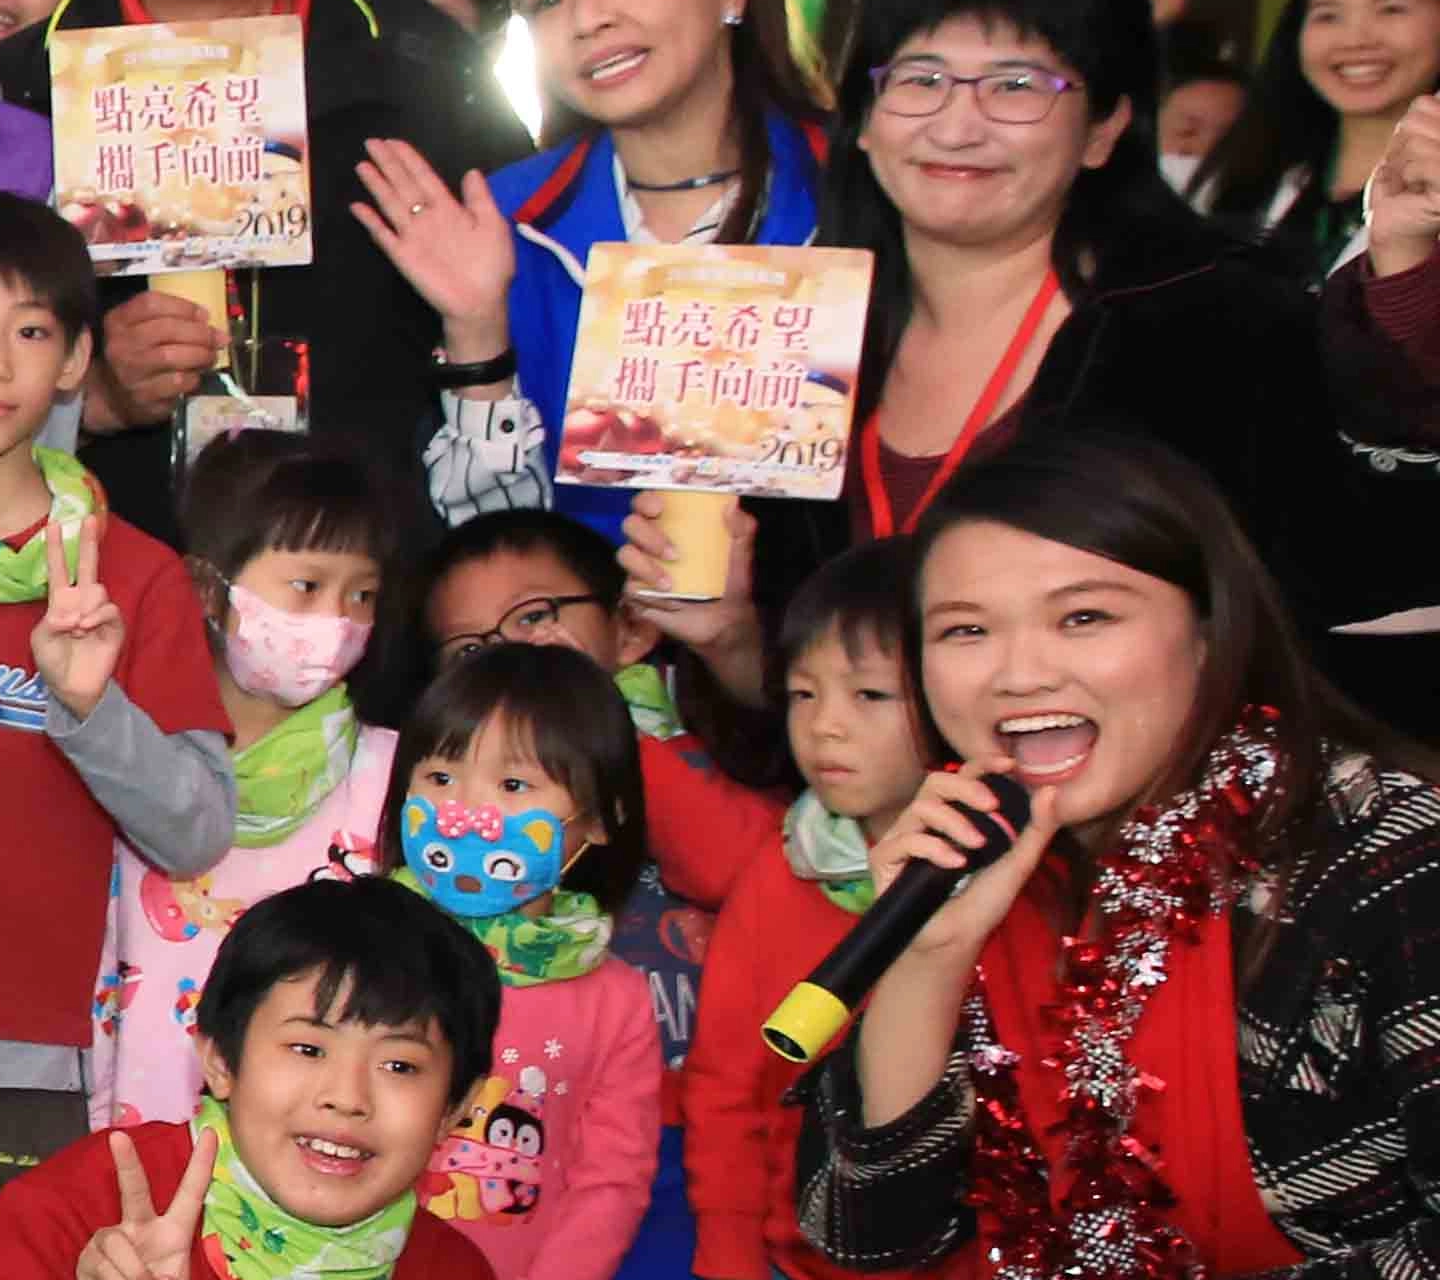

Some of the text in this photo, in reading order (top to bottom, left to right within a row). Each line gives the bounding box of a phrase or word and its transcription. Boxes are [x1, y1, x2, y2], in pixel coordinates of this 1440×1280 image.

[94, 77, 262, 133] 點亮希望
[97, 136, 262, 190] 攜手向前
[236, 203, 307, 239] 2019
[621, 300, 814, 350] 點亮希望
[614, 357, 807, 408] 攜手向前
[759, 434, 844, 472] 2019
